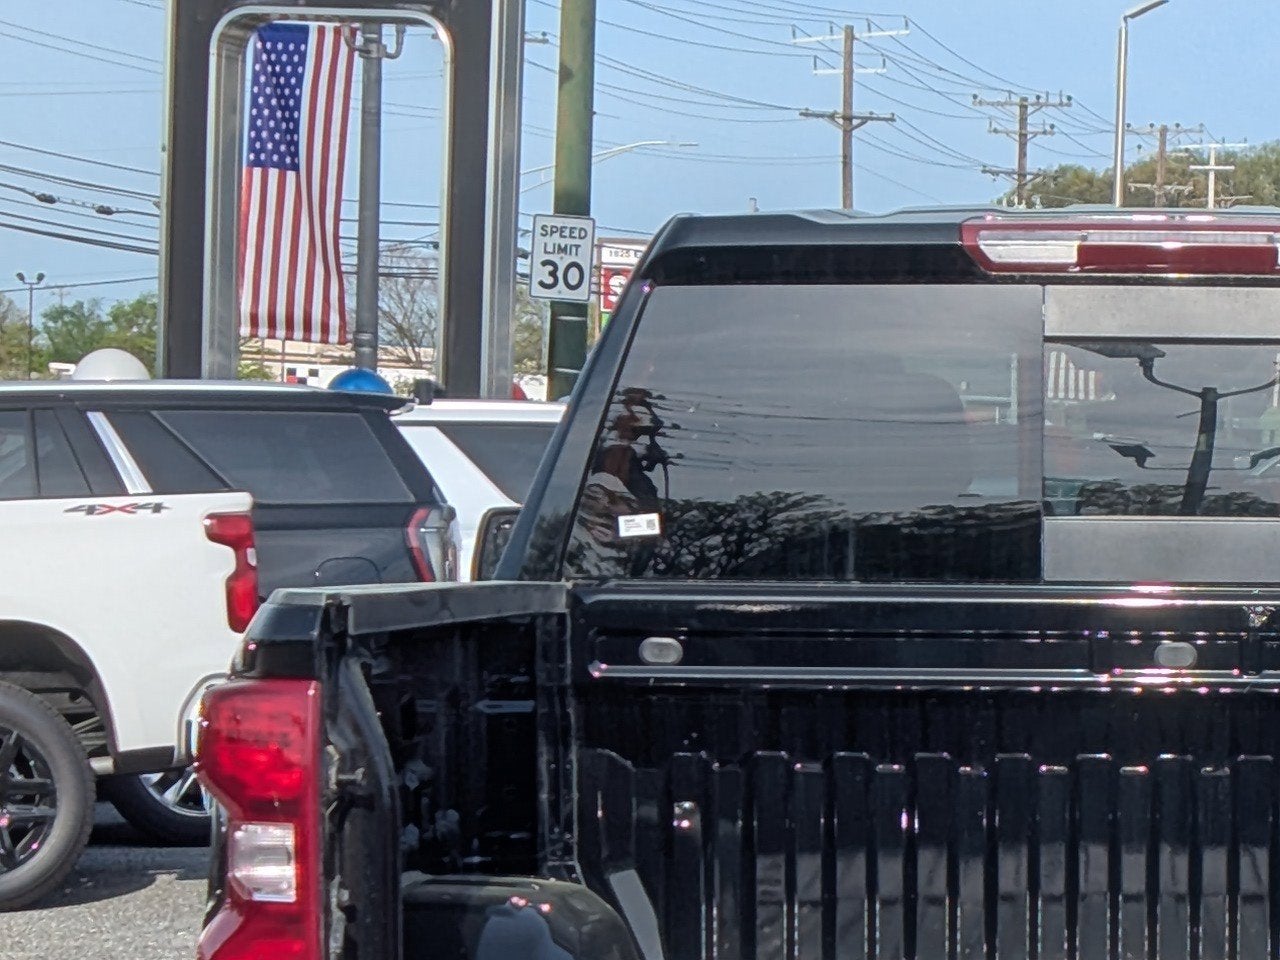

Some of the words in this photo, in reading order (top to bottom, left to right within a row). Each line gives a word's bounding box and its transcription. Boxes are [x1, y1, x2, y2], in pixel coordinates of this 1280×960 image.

[540, 224, 588, 240] SPEED
[543, 242, 582, 257] LIMIT
[537, 258, 585, 291] 30
